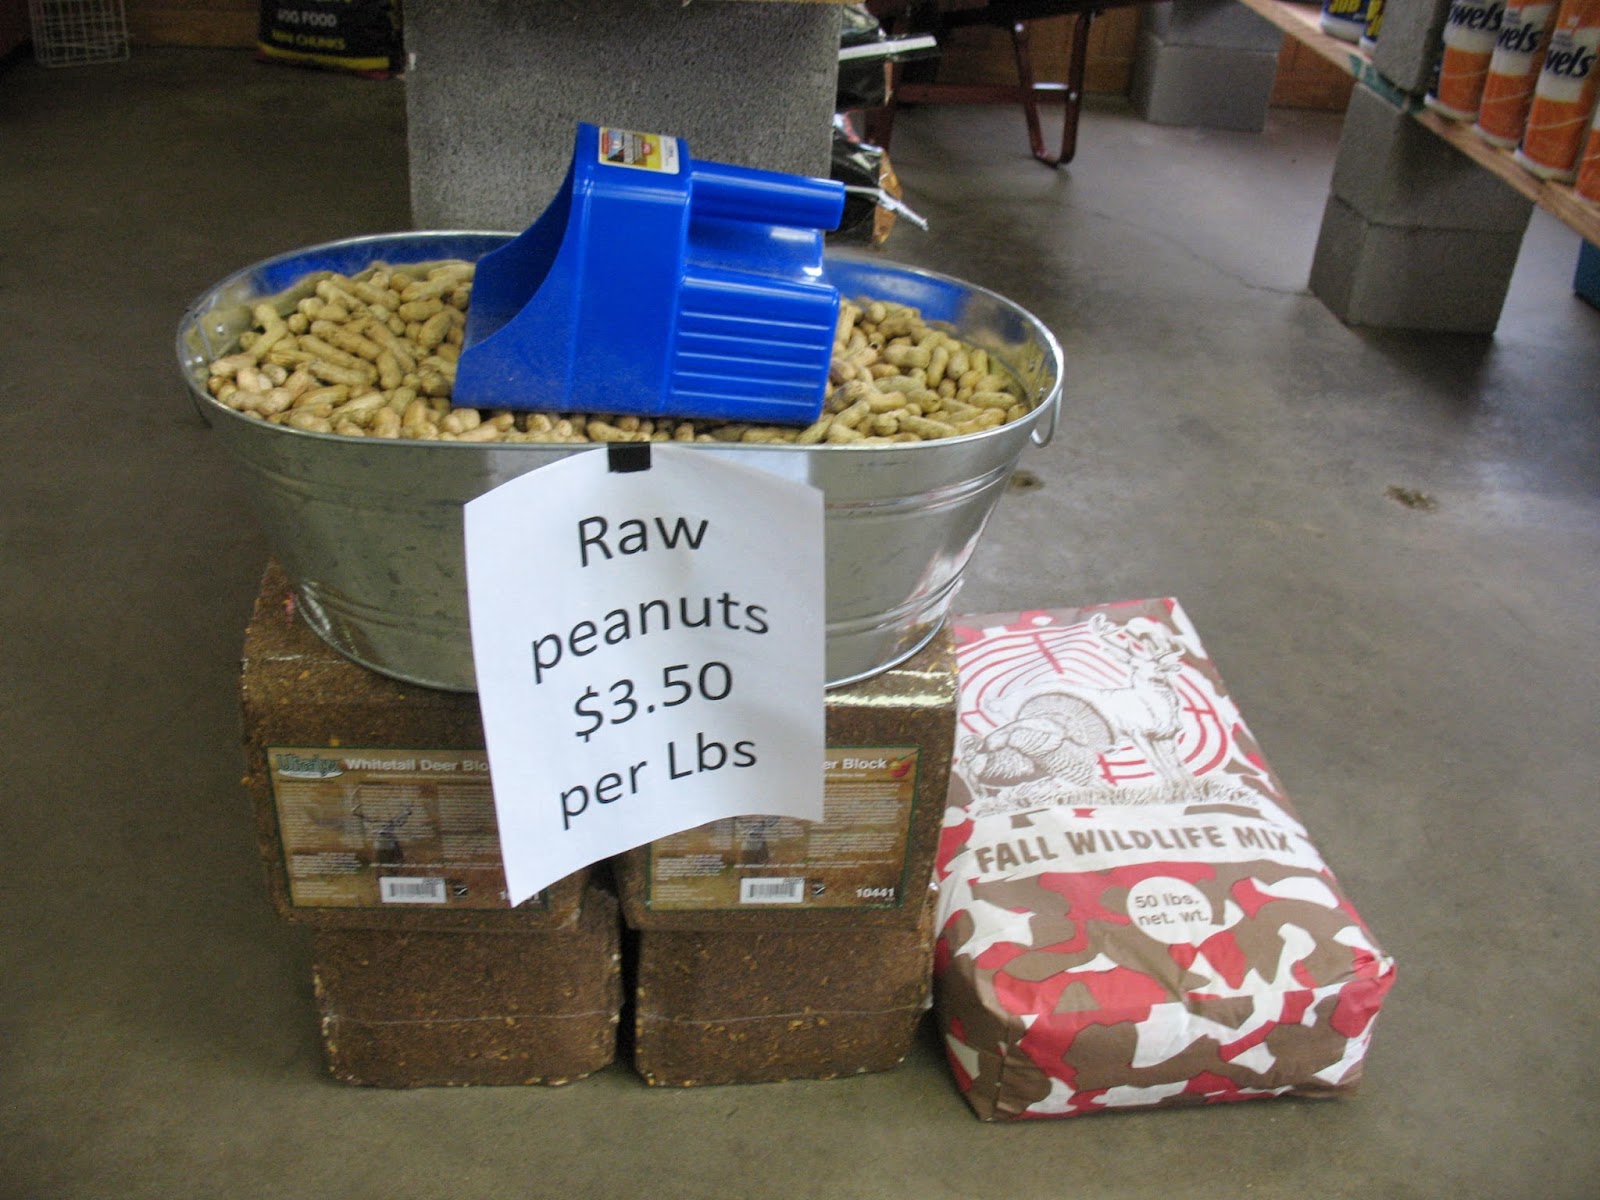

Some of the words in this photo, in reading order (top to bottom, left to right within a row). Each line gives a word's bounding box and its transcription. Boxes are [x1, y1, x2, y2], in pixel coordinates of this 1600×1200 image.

[301, 11, 338, 28] FOOD
[1447, 2, 1504, 32] wels
[579, 516, 708, 567] Raw
[532, 592, 769, 684] peanuts
[575, 660, 733, 743] $3.50
[345, 758, 416, 771] Whitetail
[420, 759, 457, 771] Deer
[463, 759, 488, 771] Blo
[823, 759, 839, 770] er
[842, 757, 888, 770] Block
[561, 761, 648, 830] per
[669, 733, 757, 779] Lbs
[976, 837, 1058, 873] FALL
[1069, 825, 1227, 857] WILDLIFE
[1235, 825, 1295, 853] MIX
[855, 887, 896, 898] 10441
[1134, 894, 1159, 910] 50
[1163, 892, 1200, 907] lbs.
[1138, 910, 1174, 926] net.
[1179, 909, 1211, 925] wt.
